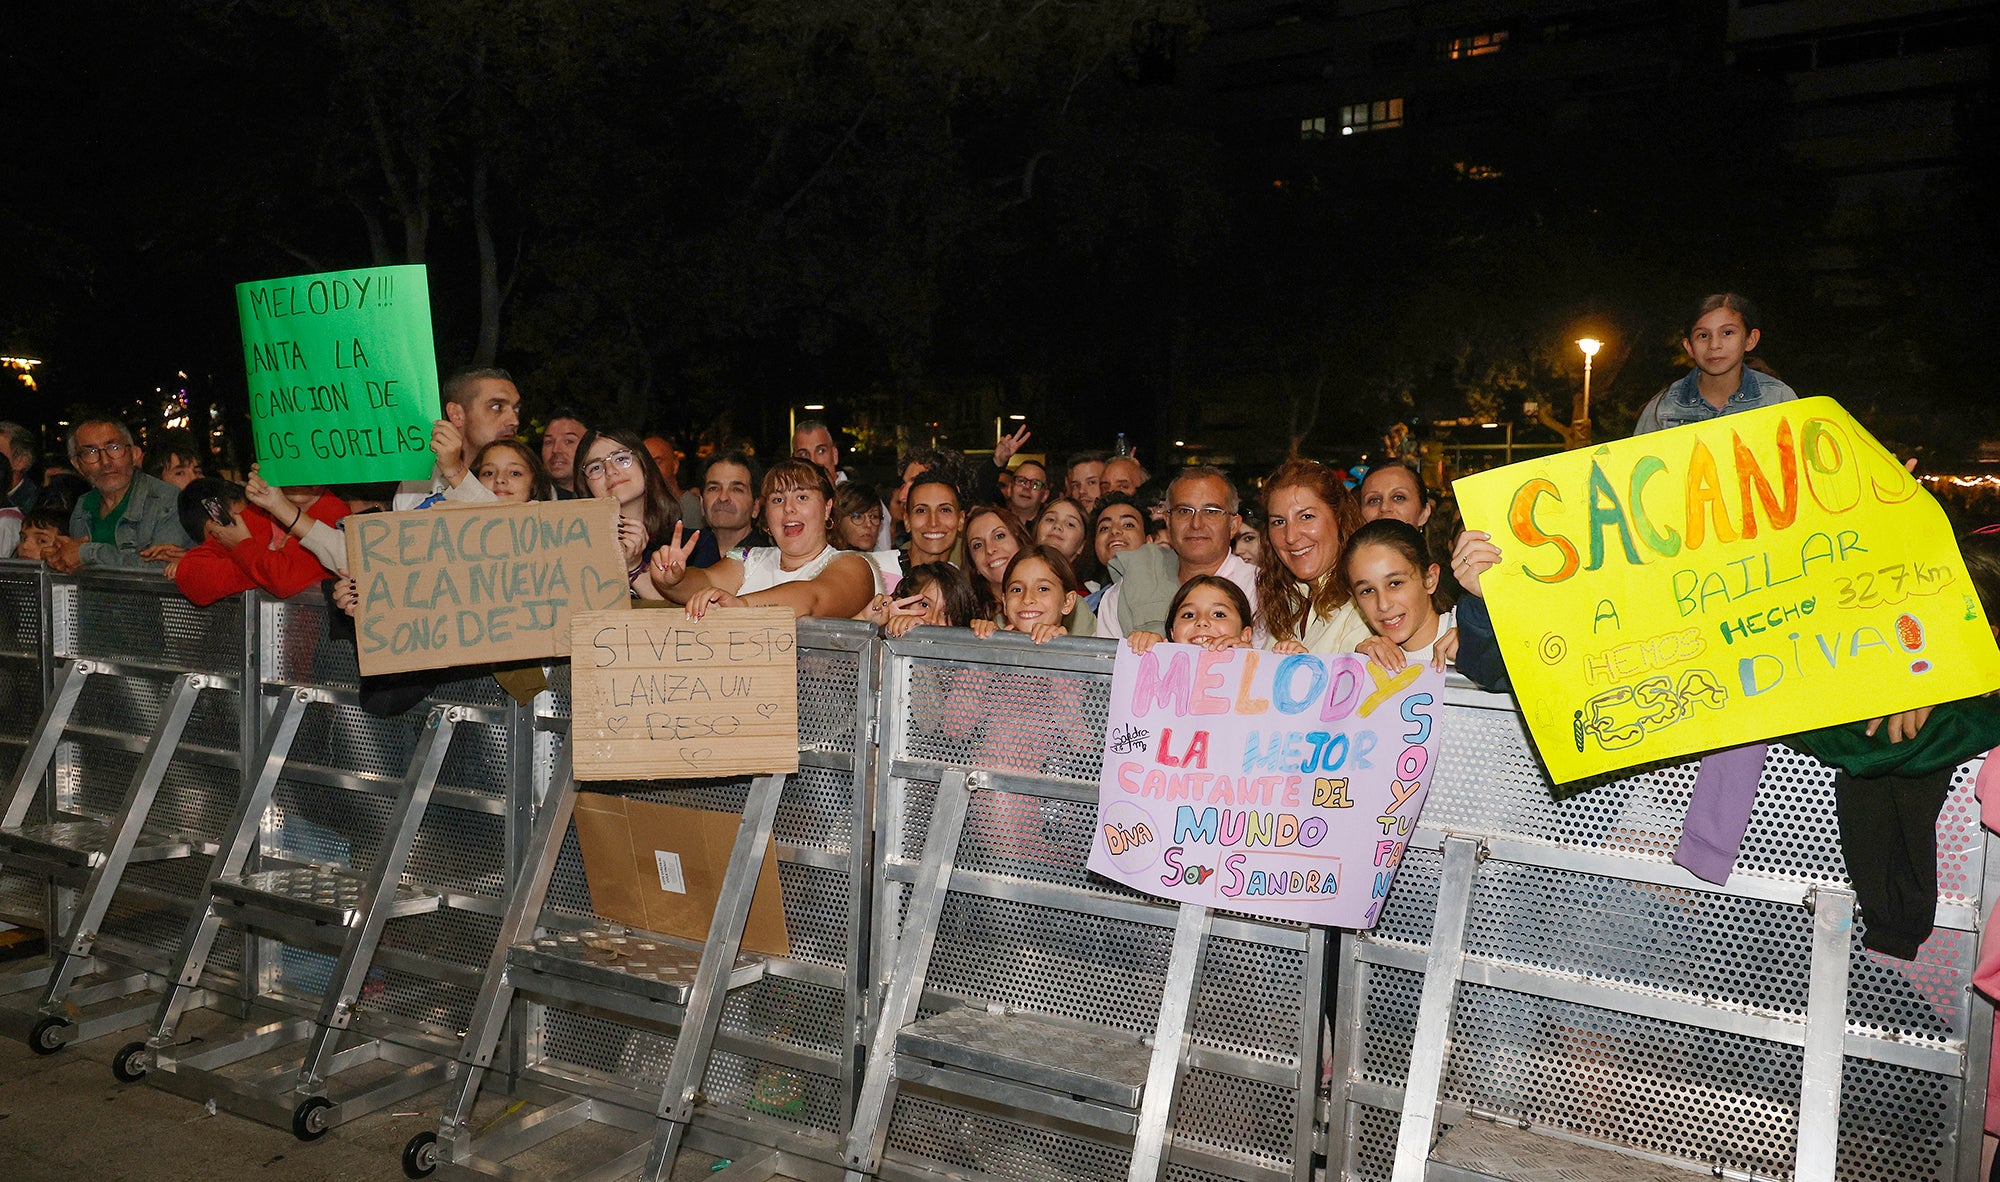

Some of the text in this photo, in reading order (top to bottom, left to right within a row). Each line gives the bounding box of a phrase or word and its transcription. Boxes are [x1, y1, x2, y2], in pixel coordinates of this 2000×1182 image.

[250, 275, 393, 321] MELODY!!!
[336, 338, 369, 369] LA
[254, 381, 398, 419] CANCION DE
[256, 425, 425, 461] LOS GORILAS
[359, 516, 592, 572] REACCIONA
[366, 557, 570, 612] A LA NUEVA
[1594, 530, 1868, 634] A BAILAR
[362, 598, 568, 655] SONG DE JJ
[645, 627, 714, 662] VES
[729, 627, 794, 662] ESTO
[1584, 627, 1707, 685] HEMOS
[1720, 596, 1816, 644] HECHO
[613, 674, 752, 707] LANZA UN
[1131, 650, 1425, 722] MELODY
[646, 712, 740, 741] BESO
[1155, 728, 1378, 773] LA MEJOR
[1118, 762, 1354, 808] CANTANTE DEL
[1174, 805, 1328, 848] MUNDO
